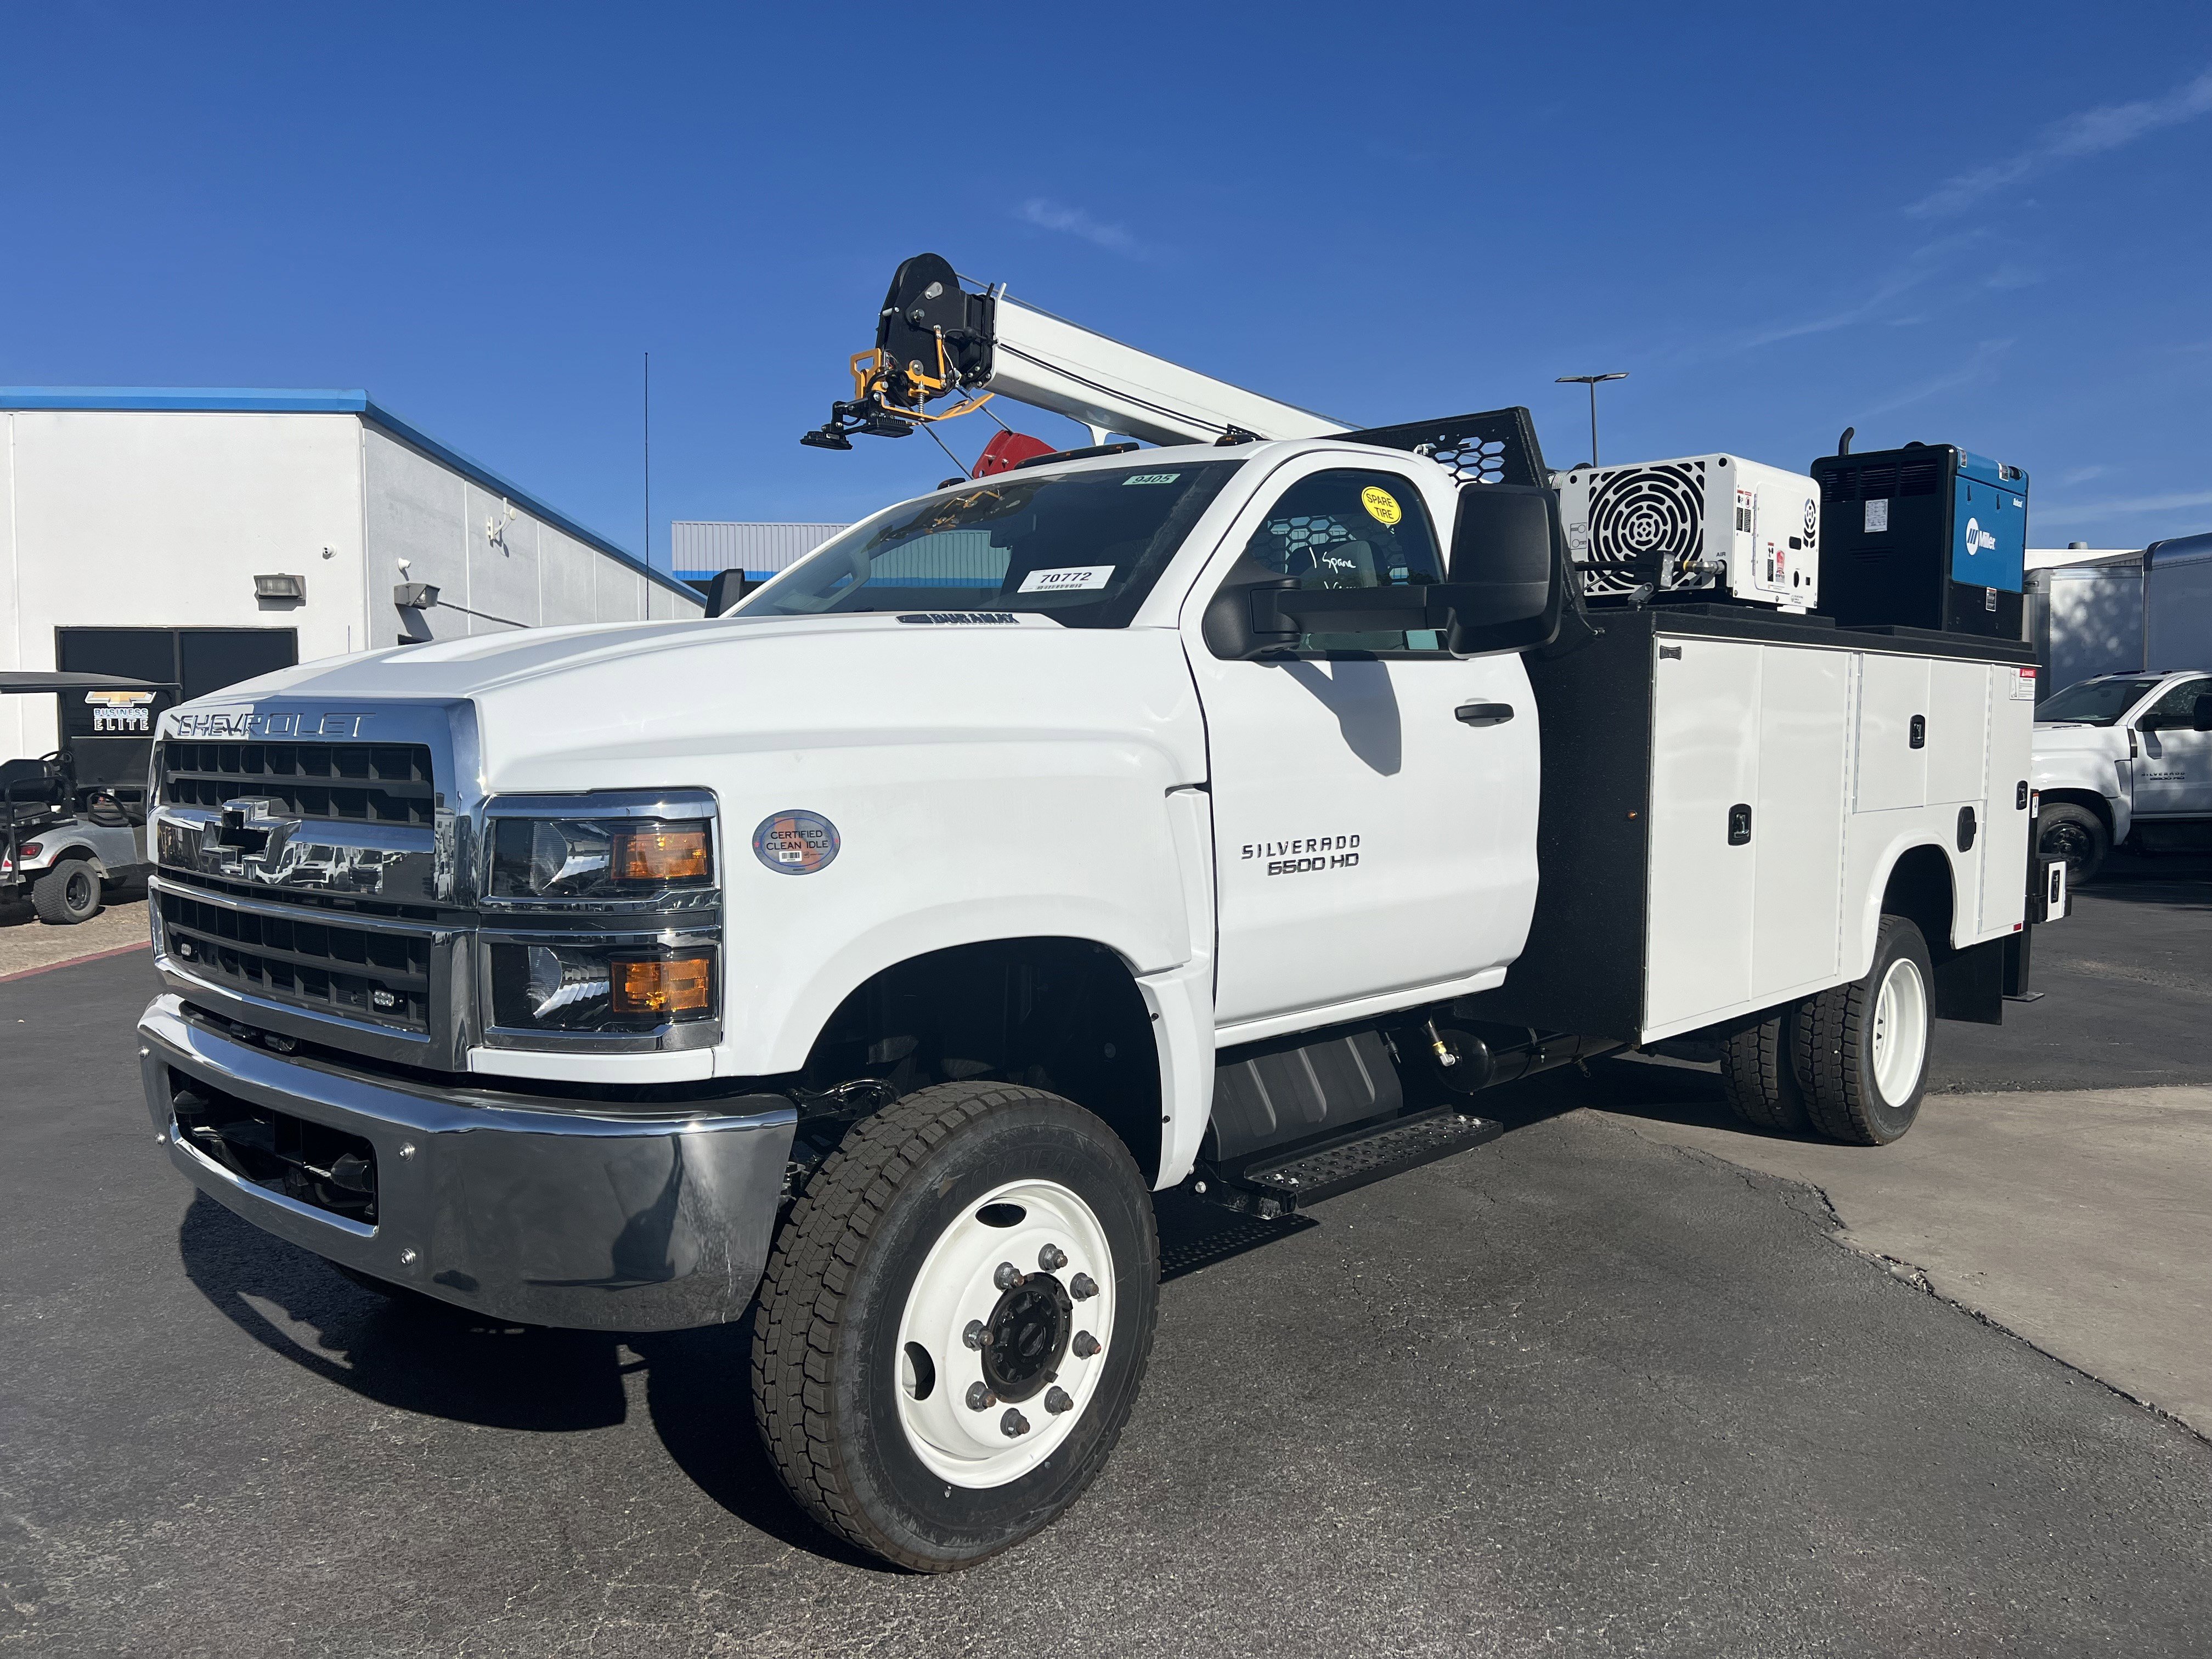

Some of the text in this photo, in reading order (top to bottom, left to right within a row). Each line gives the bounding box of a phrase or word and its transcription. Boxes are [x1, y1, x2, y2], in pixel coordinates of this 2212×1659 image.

[1132, 475, 1172, 483] 9405
[1366, 493, 1394, 507] SPARE
[1374, 507, 1394, 520] TIRE
[1978, 530, 1995, 550] Miller
[1040, 572, 1092, 583] 70772
[929, 613, 1020, 625] DURAMAX
[94, 708, 148, 716] BUSINESS
[94, 718, 149, 731] ELITE
[177, 713, 376, 737] CHEVROLET
[770, 830, 823, 839] CERTIFIED
[766, 840, 829, 850] CLEAN IDLE
[1240, 834, 1360, 860] SILVERADO
[1266, 853, 1359, 876] 6500 HD
